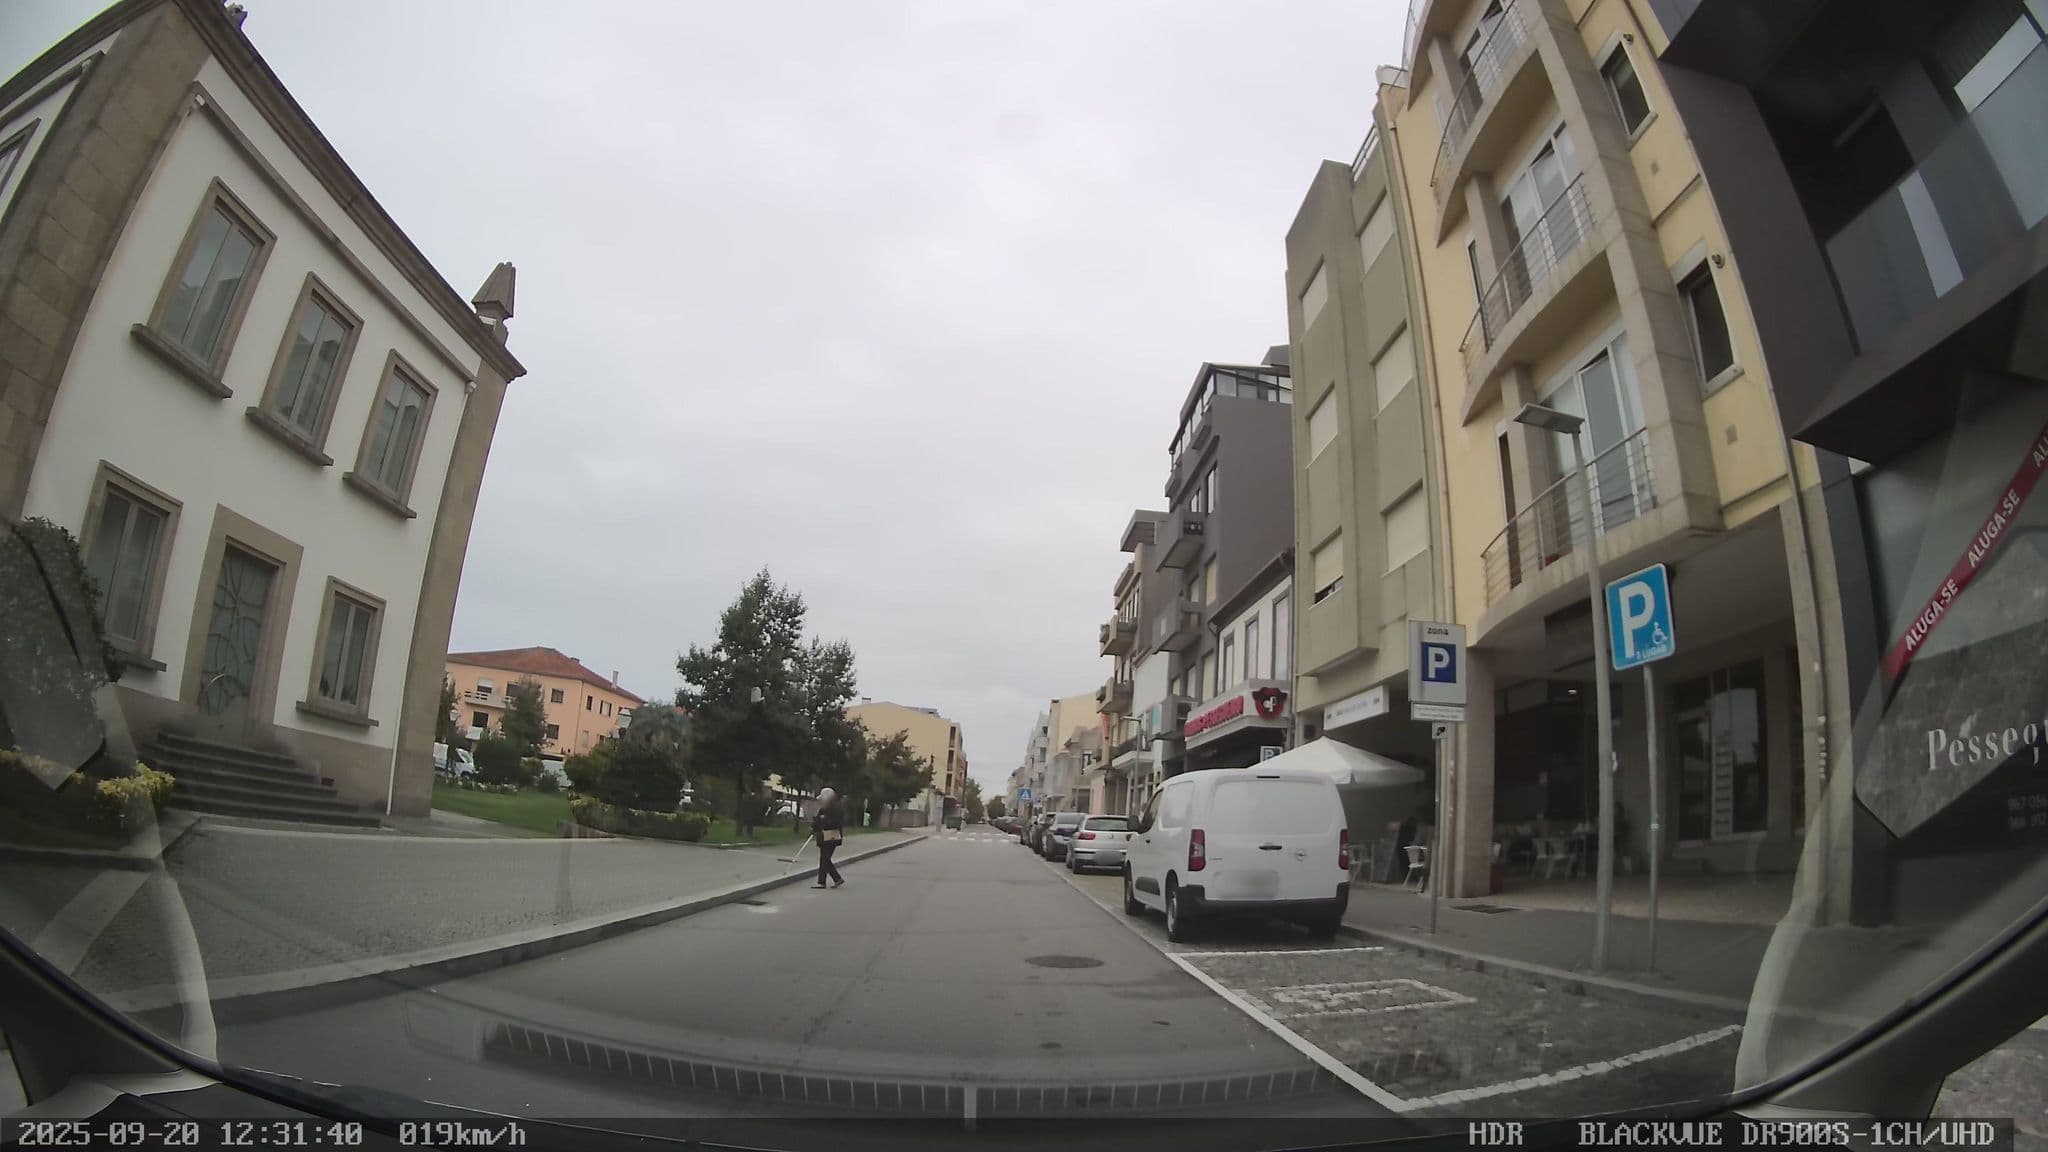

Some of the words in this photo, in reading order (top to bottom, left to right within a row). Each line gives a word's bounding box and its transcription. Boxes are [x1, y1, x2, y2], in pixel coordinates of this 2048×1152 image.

[1967, 488, 2021, 568] ALUGA-SE
[1427, 627, 1449, 636] zona
[1619, 581, 1655, 658] P
[1905, 578, 1959, 651] ALUGA-SE
[1428, 646, 1450, 678] P
